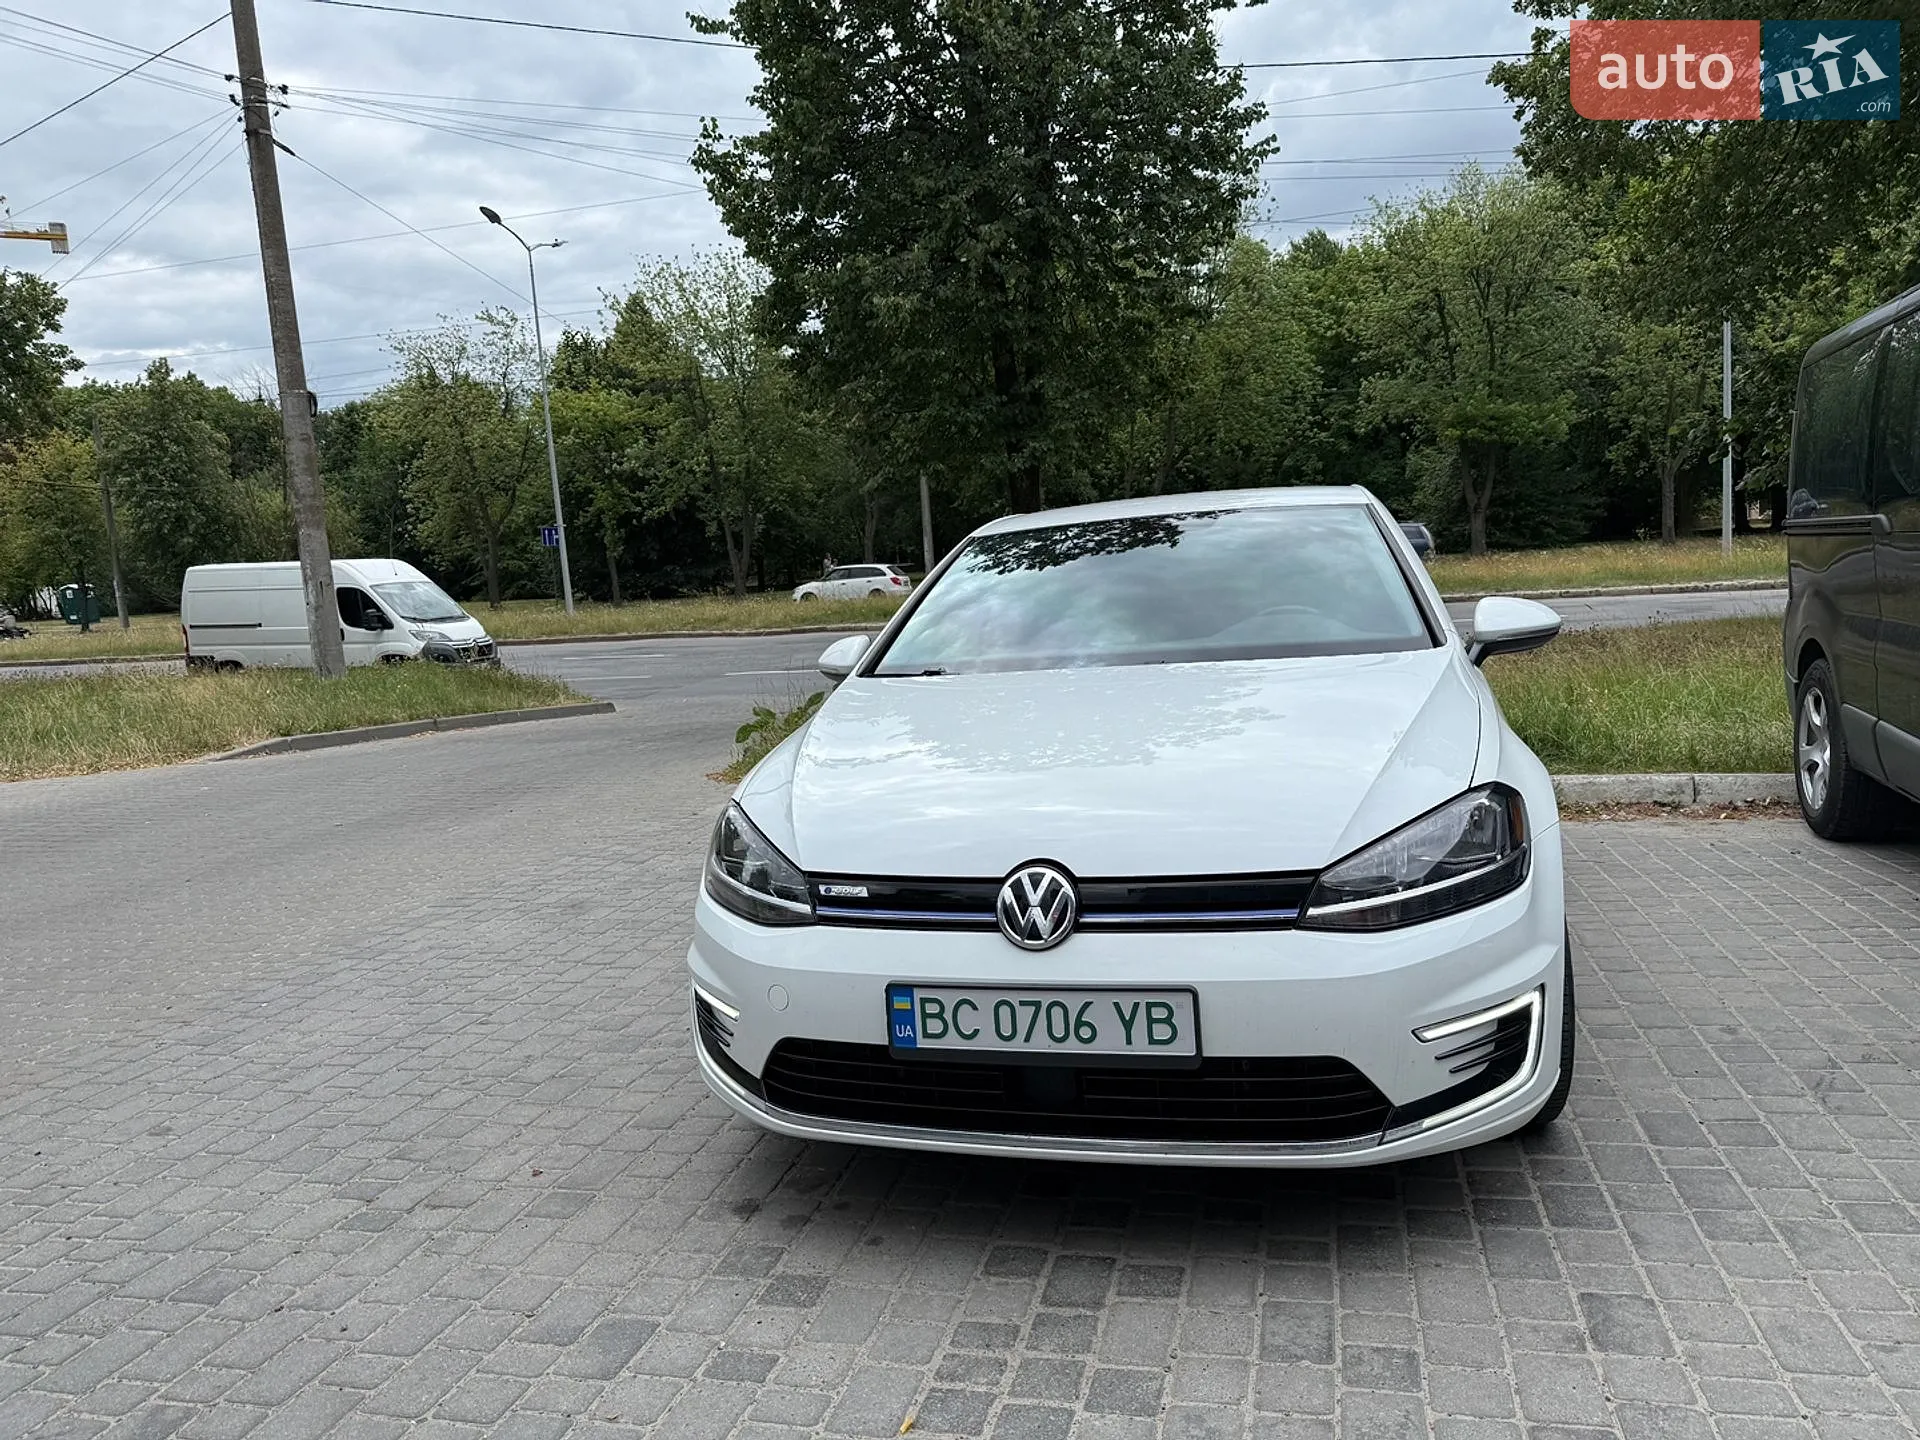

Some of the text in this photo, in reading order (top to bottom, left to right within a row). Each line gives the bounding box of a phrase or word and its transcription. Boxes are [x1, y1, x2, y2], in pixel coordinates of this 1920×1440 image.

[896, 1024, 914, 1038] UA
[919, 997, 1179, 1046] BC 0706 YB
